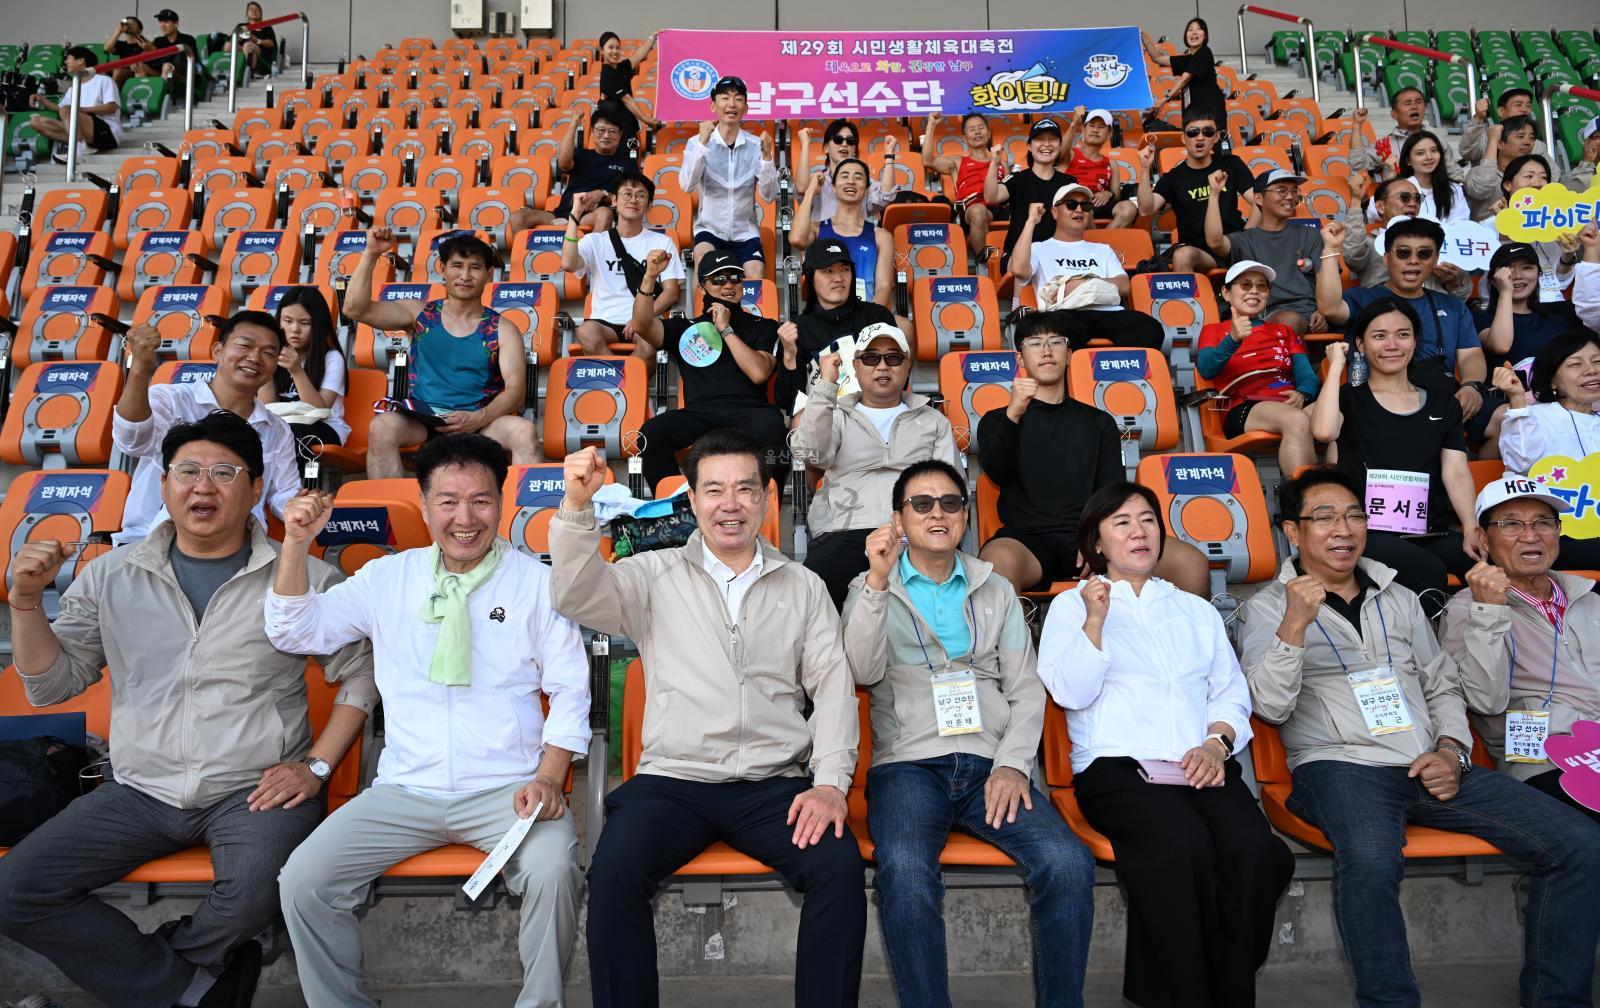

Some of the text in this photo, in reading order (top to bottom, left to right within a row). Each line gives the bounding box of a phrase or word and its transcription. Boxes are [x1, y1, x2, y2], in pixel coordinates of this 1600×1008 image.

[781, 38, 1014, 56] 제29회 시민생활체육대축전
[948, 60, 973, 72] 남구
[747, 80, 945, 115] 남구선수단
[970, 79, 1069, 107] 화이팅!!
[1187, 185, 1228, 199] YN
[914, 229, 943, 238] 관계자석
[54, 236, 87, 246] 관계자석
[149, 236, 181, 245] 관계자석
[244, 236, 276, 245] 관계자석
[342, 236, 368, 245] 관계자
[1455, 238, 1491, 257] 남구
[1055, 258, 1099, 268] YNRA
[937, 284, 972, 294] 관계자석
[1155, 281, 1191, 291] 관계자석
[51, 293, 88, 303] 관계자석
[162, 292, 199, 302] 관계자석
[386, 291, 422, 301] 관계자석
[499, 289, 535, 299] 관계자석
[969, 360, 1011, 372] 관계자석
[1099, 358, 1141, 371] 관계자석
[47, 371, 90, 383] 관계자석
[180, 371, 217, 383] 관계자
[575, 366, 617, 379] 관계자석
[1175, 467, 1226, 481] 관계자석
[529, 479, 566, 492] 관계자
[40, 486, 93, 499] 관계자석
[1368, 497, 1387, 516] 문
[1392, 499, 1412, 519] 서
[325, 519, 380, 533] 관계자석
[1360, 693, 1400, 706] 남구 선수단
[1509, 724, 1546, 733] 남구 선수단
